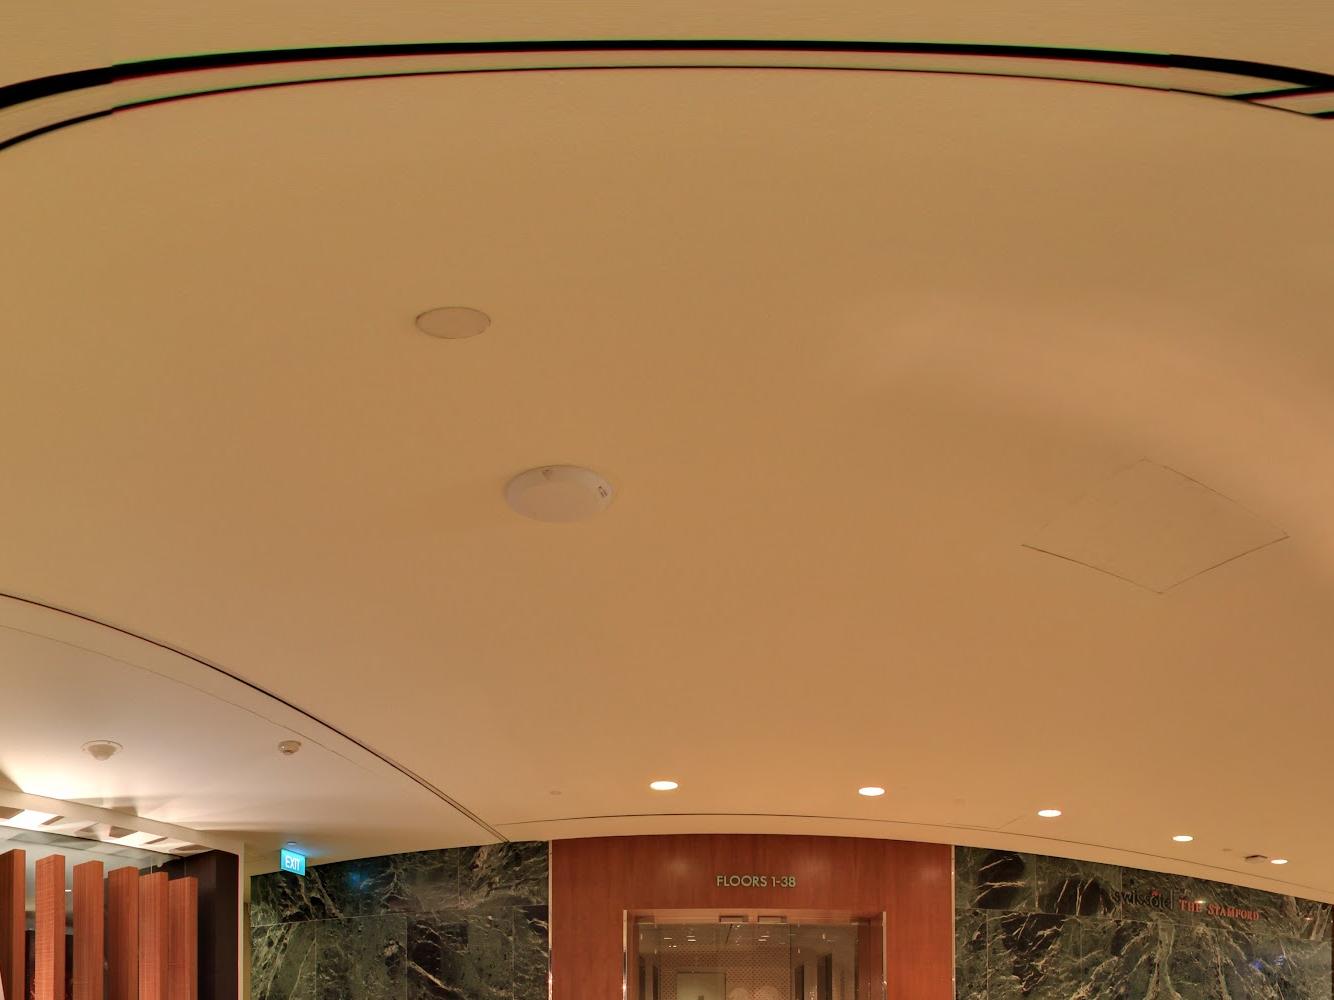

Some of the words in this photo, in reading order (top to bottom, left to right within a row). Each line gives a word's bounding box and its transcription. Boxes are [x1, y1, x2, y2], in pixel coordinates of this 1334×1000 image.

[285, 855, 300, 871] EXIT
[716, 875, 768, 887] FLOORS
[771, 876, 796, 887] 1-38
